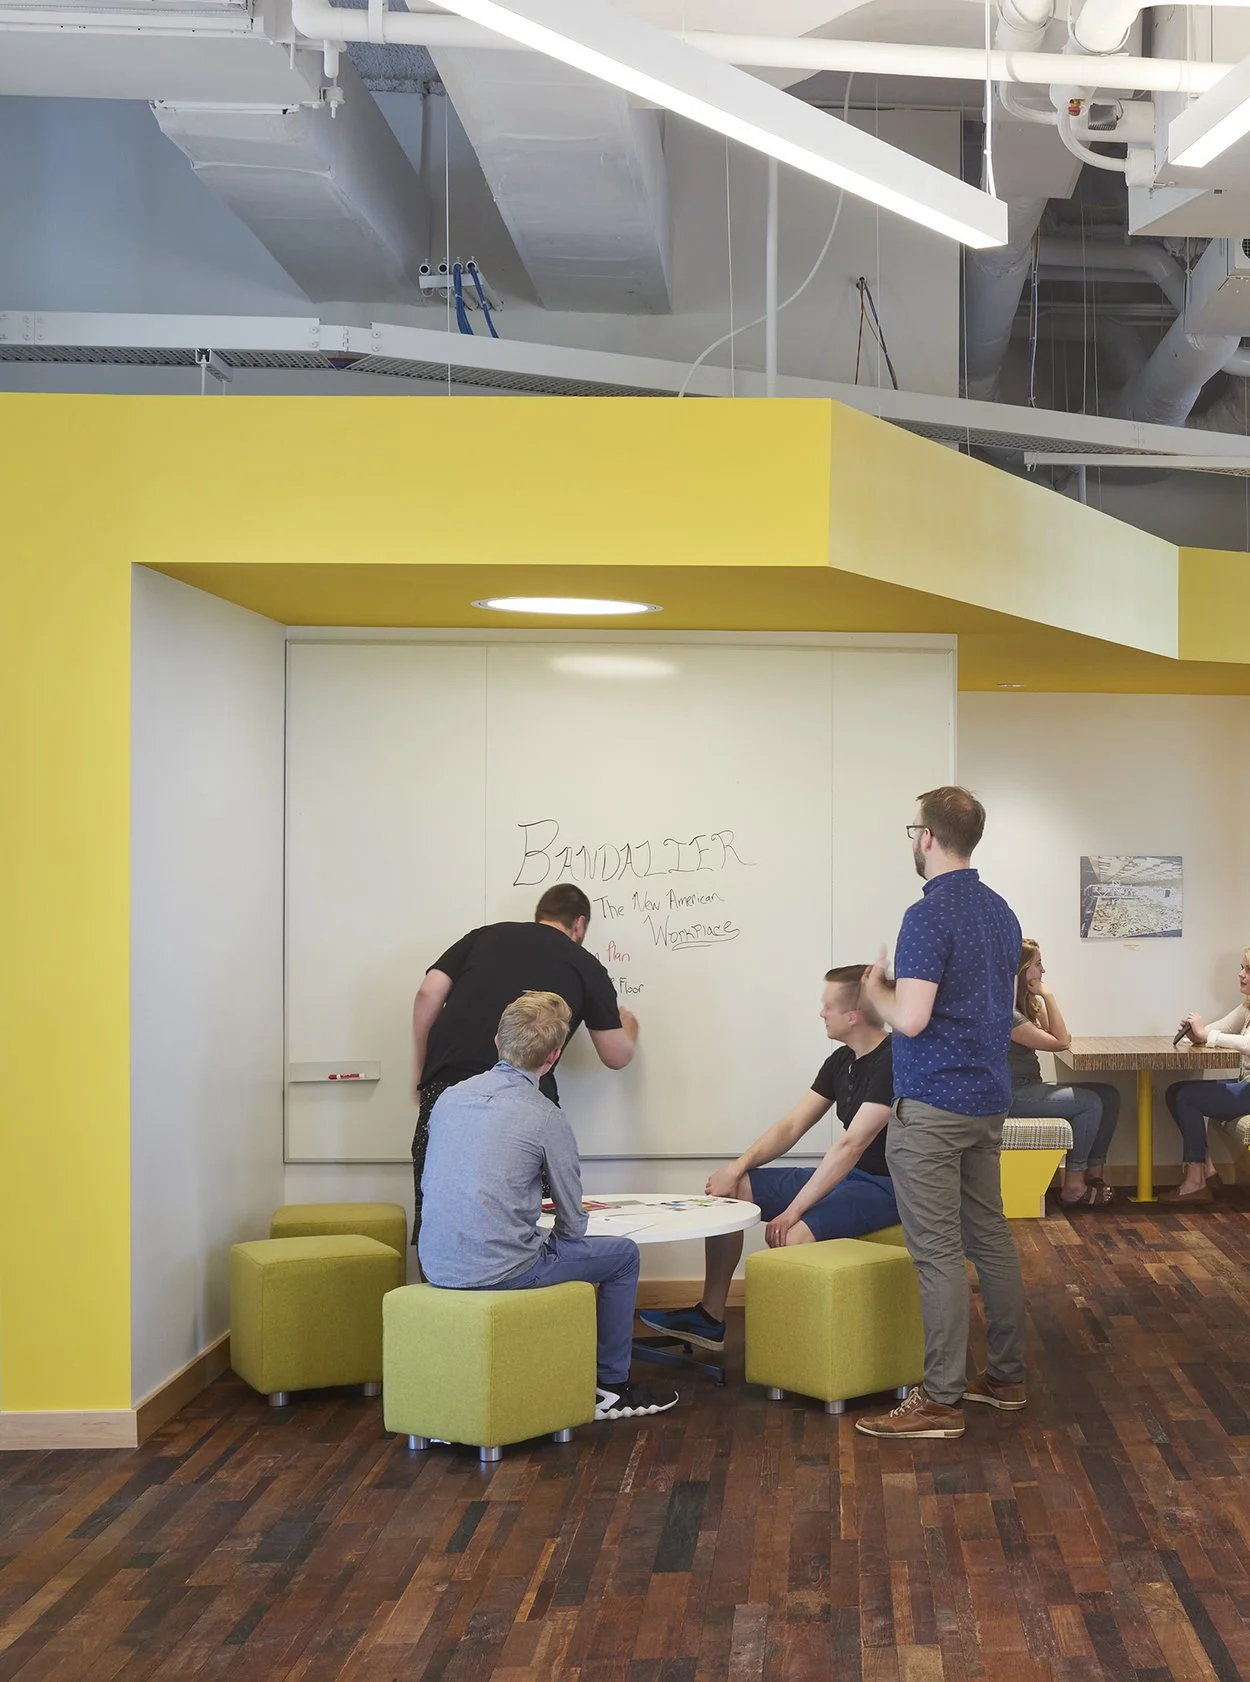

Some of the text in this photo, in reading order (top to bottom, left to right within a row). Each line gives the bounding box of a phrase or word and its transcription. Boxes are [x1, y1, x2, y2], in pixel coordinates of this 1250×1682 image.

[513, 819, 757, 886] BANDALIER
[593, 888, 725, 919] The New American
[607, 940, 630, 962] Plan
[619, 977, 645, 994] Floor
